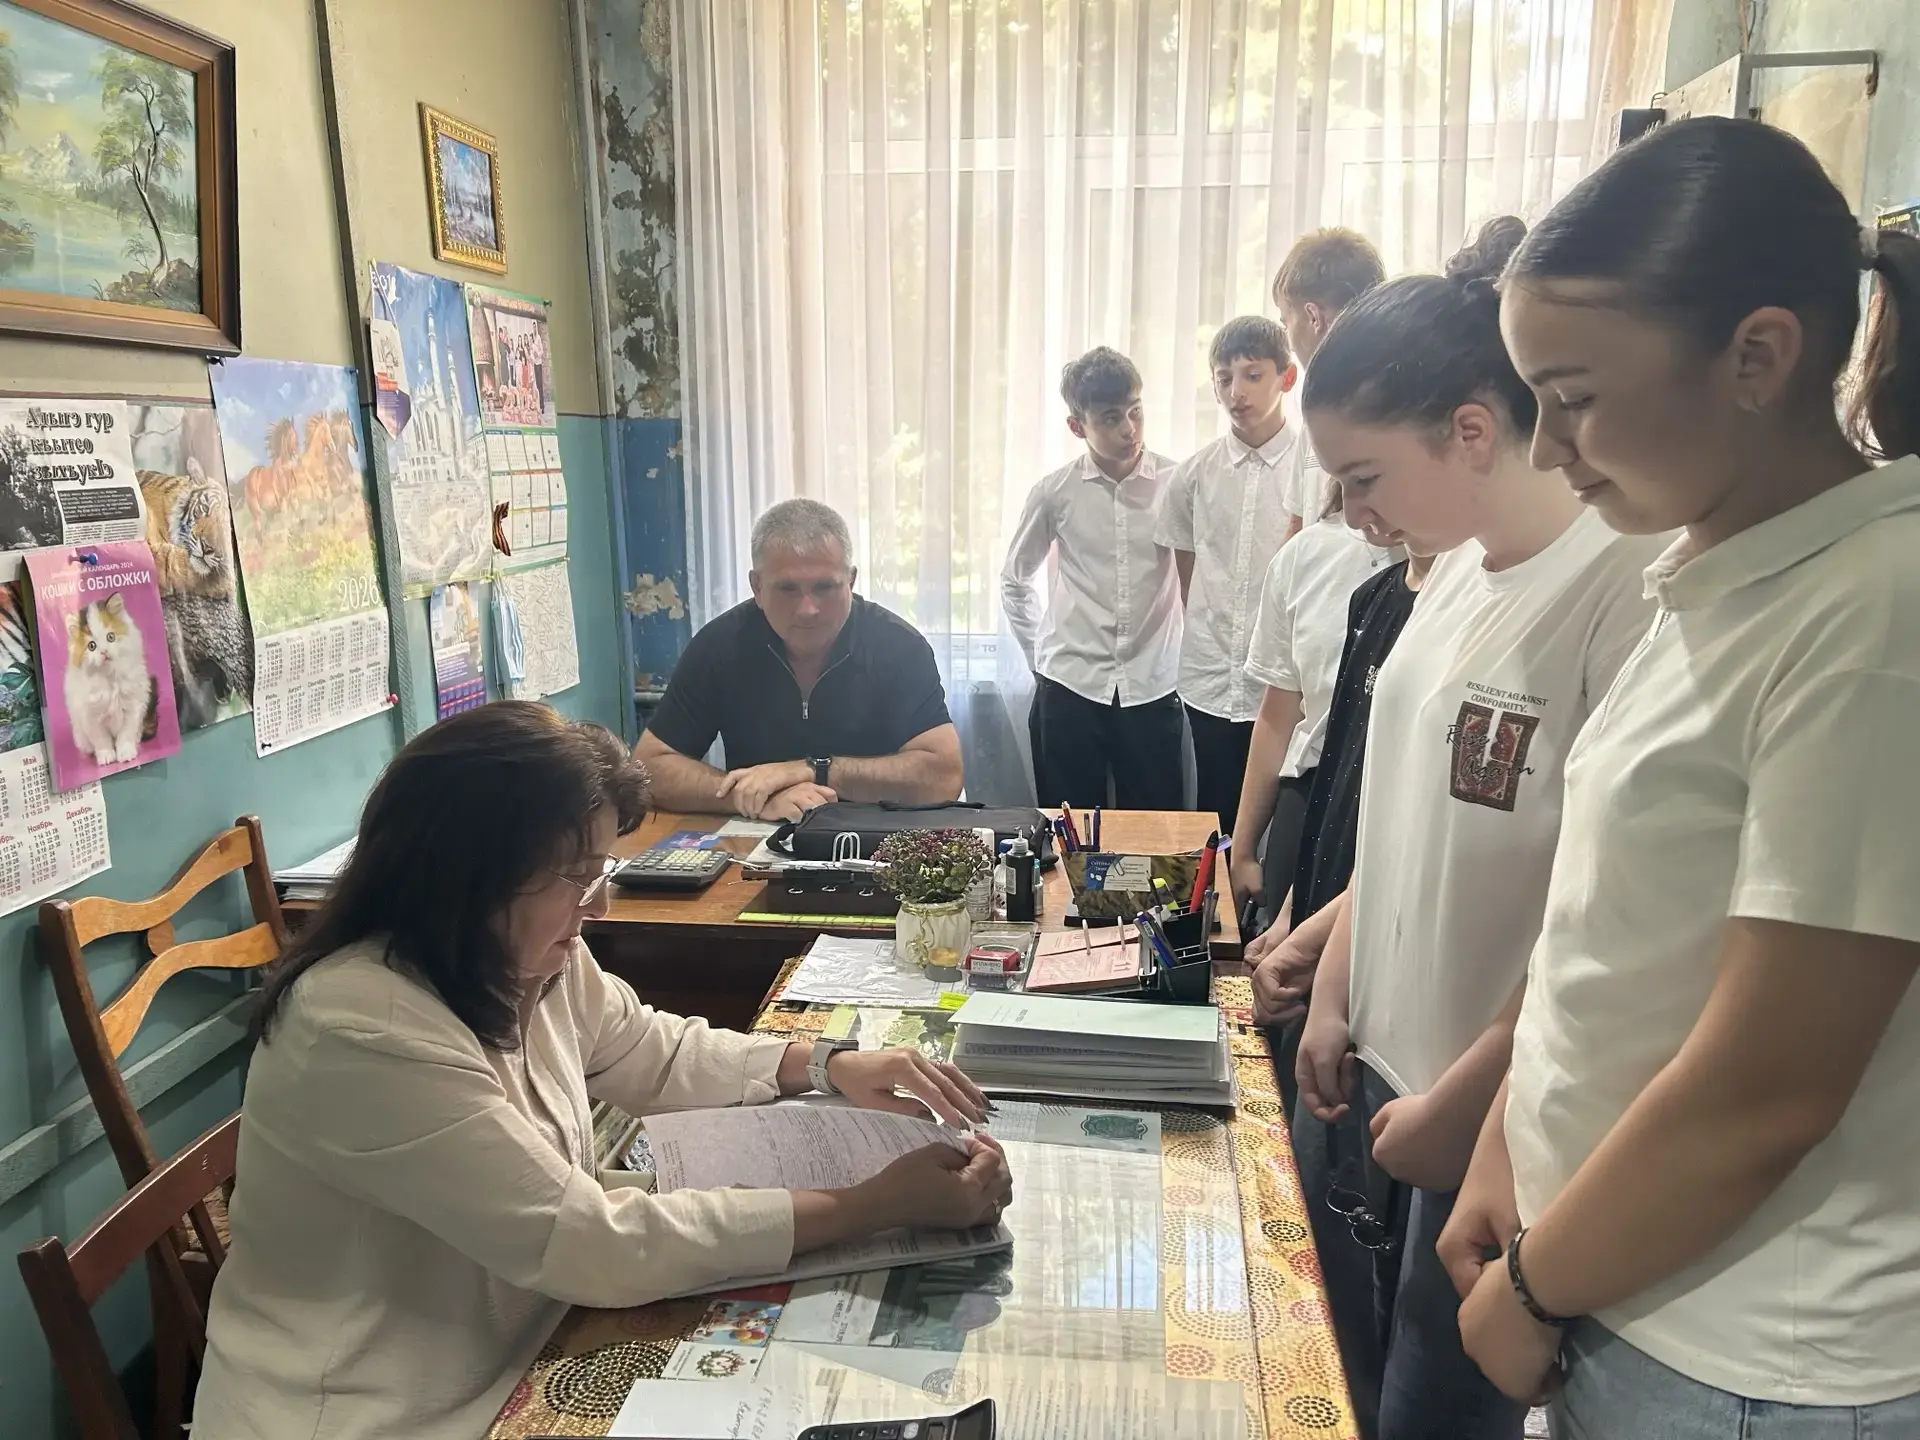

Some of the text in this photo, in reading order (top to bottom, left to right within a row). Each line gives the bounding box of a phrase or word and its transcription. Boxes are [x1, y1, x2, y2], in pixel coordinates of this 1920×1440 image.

[26, 407, 114, 433] Адыгэ гур
[41, 581, 76, 600] КОШКИ
[78, 578, 86, 592] С
[86, 570, 151, 591] ОБЛОЖКИ
[339, 574, 379, 612] 2026
[23, 757, 37, 766] Май
[65, 806, 92, 820] Декабрь
[27, 821, 53, 834] Ноябрь
